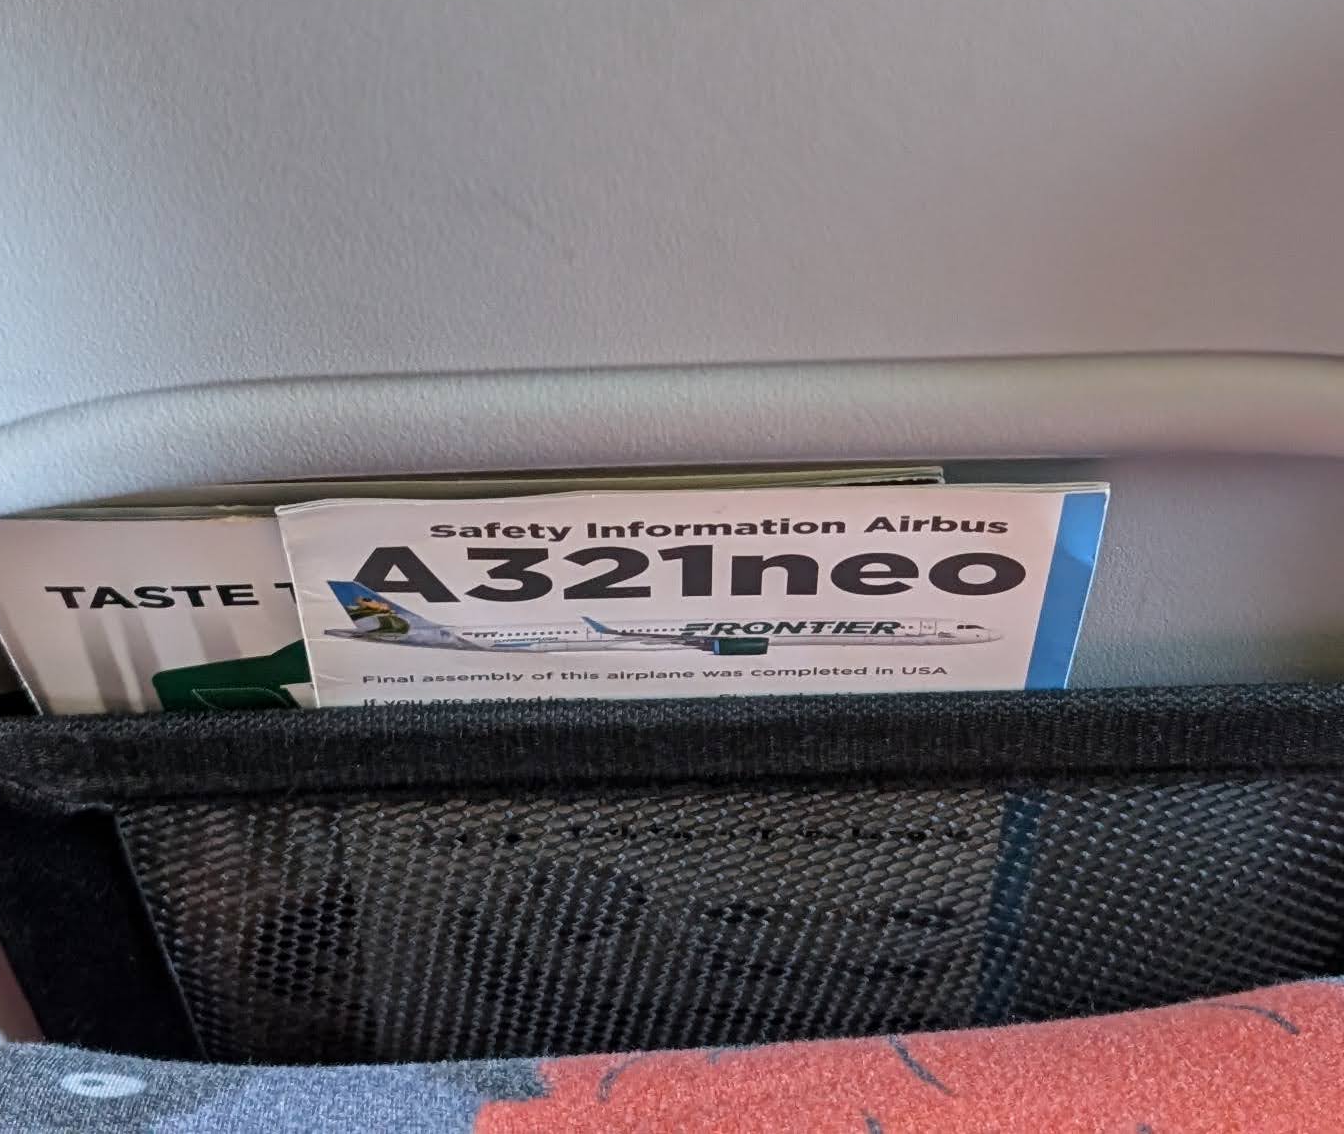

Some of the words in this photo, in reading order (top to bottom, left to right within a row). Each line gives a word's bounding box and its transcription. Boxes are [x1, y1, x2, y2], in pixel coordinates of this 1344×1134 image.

[430, 522, 572, 542] Safety
[587, 518, 846, 538] Information
[864, 515, 1009, 534] Airbus
[353, 545, 1027, 603] A321neo
[44, 583, 260, 609] TASTE
[681, 620, 902, 636] FRONTIER
[362, 675, 415, 684] Final
[422, 671, 524, 682] assembly
[532, 671, 553, 681] of
[560, 671, 600, 681] this
[607, 669, 696, 681] airplane
[702, 669, 743, 678] was
[750, 667, 868, 680] completed
[875, 667, 894, 676] in
[902, 666, 948, 676] USA
